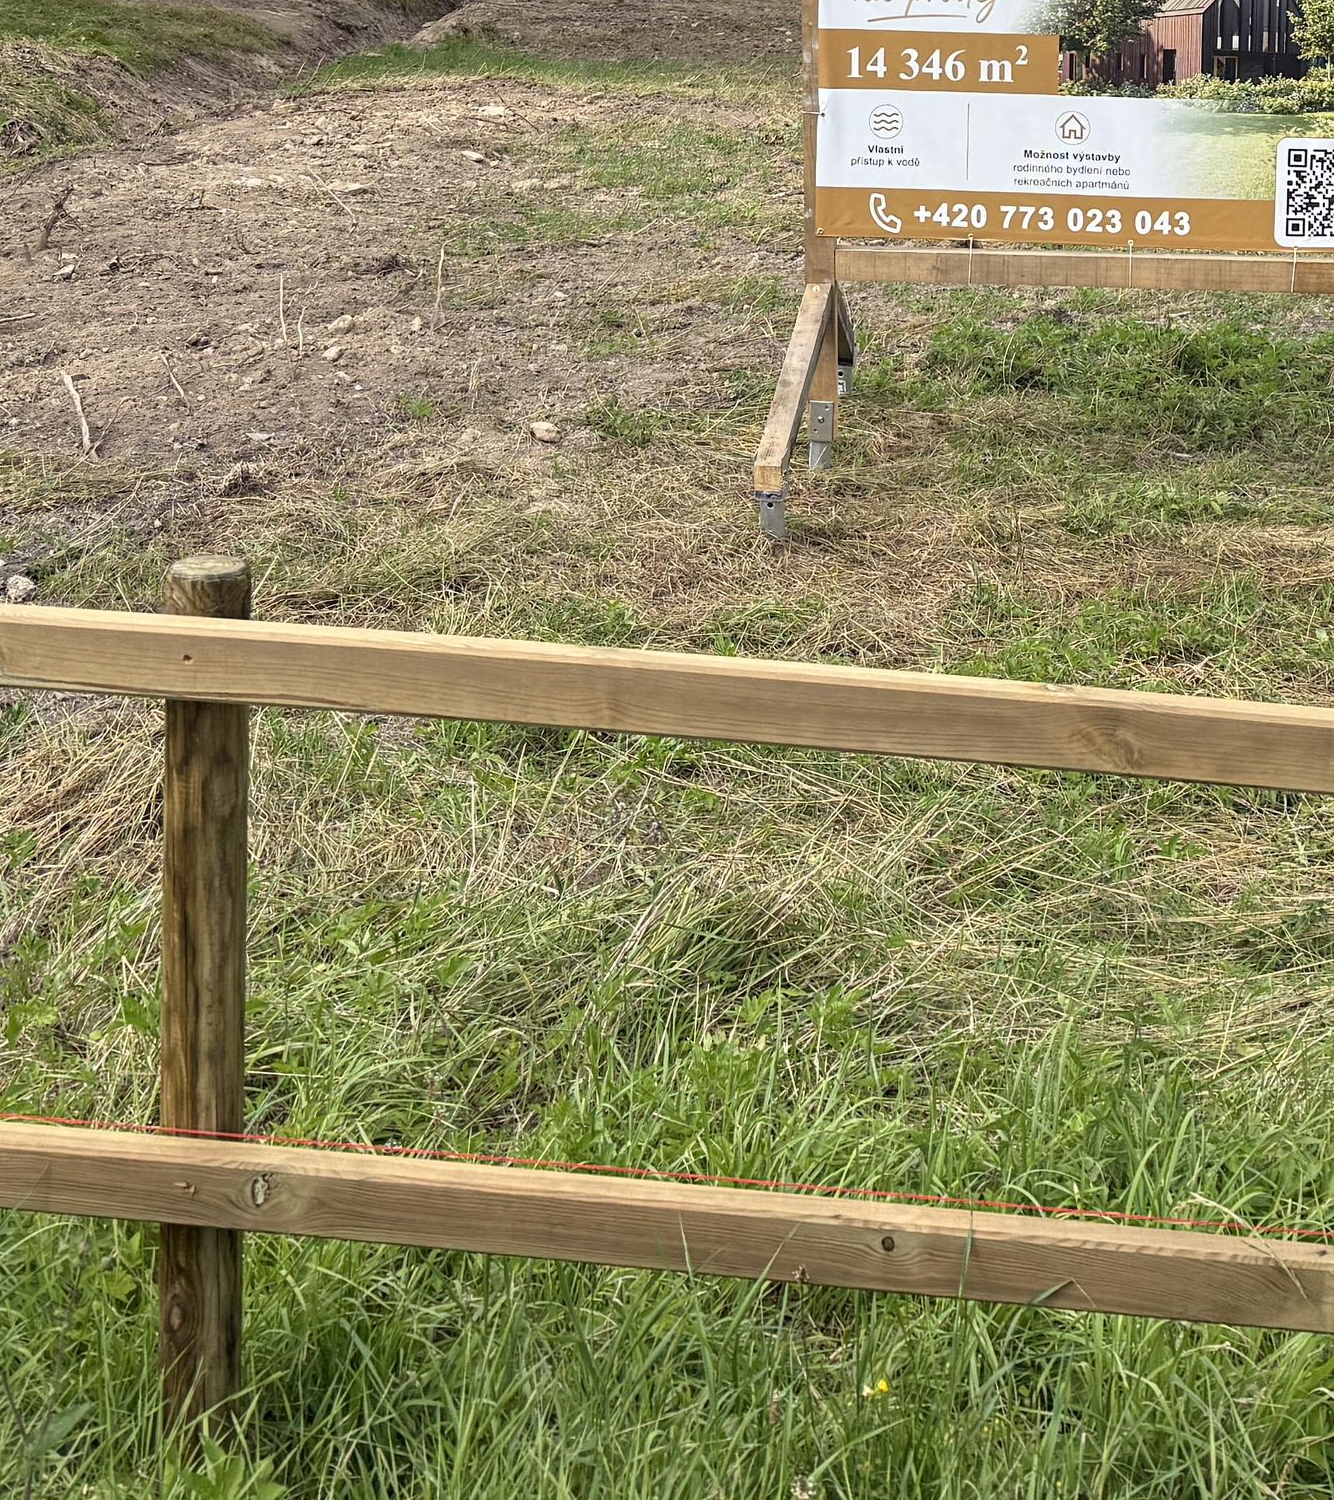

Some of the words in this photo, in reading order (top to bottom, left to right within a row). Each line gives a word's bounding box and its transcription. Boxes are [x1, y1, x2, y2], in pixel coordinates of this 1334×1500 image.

[846, 46, 887, 78] 14
[898, 48, 966, 82] 346
[887, 158, 893, 166] k
[1024, 149, 1069, 160] Možnost
[1072, 151, 1121, 163] výstavby
[1106, 167, 1131, 176] nebo
[913, 202, 988, 229] +420
[1000, 205, 1054, 230] 773
[1067, 208, 1123, 234] 023
[1134, 210, 1192, 236] 043
